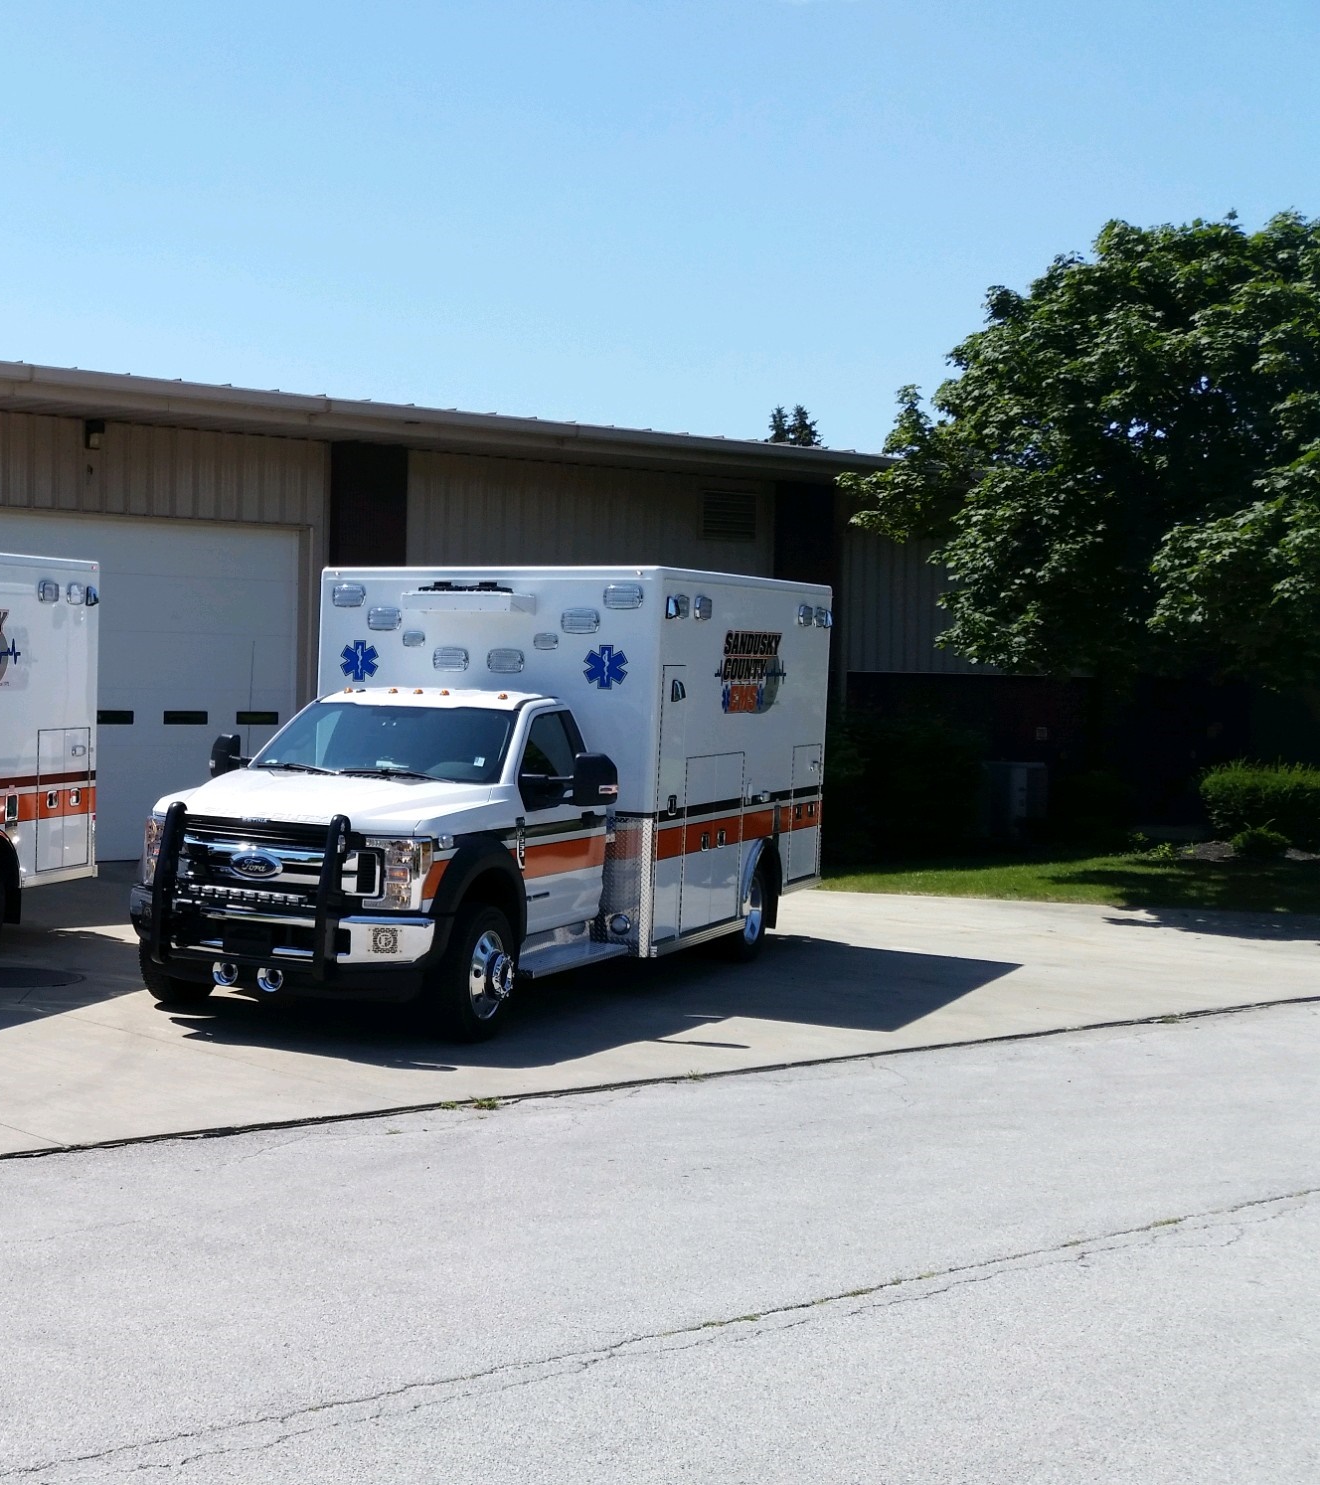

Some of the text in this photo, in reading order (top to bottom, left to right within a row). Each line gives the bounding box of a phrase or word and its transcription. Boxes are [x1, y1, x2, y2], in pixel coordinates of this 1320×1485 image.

[724, 631, 782, 655] SANDUSKY
[723, 658, 767, 680] COUNTY
[728, 685, 758, 712] EMS
[242, 858, 267, 872] Ford
